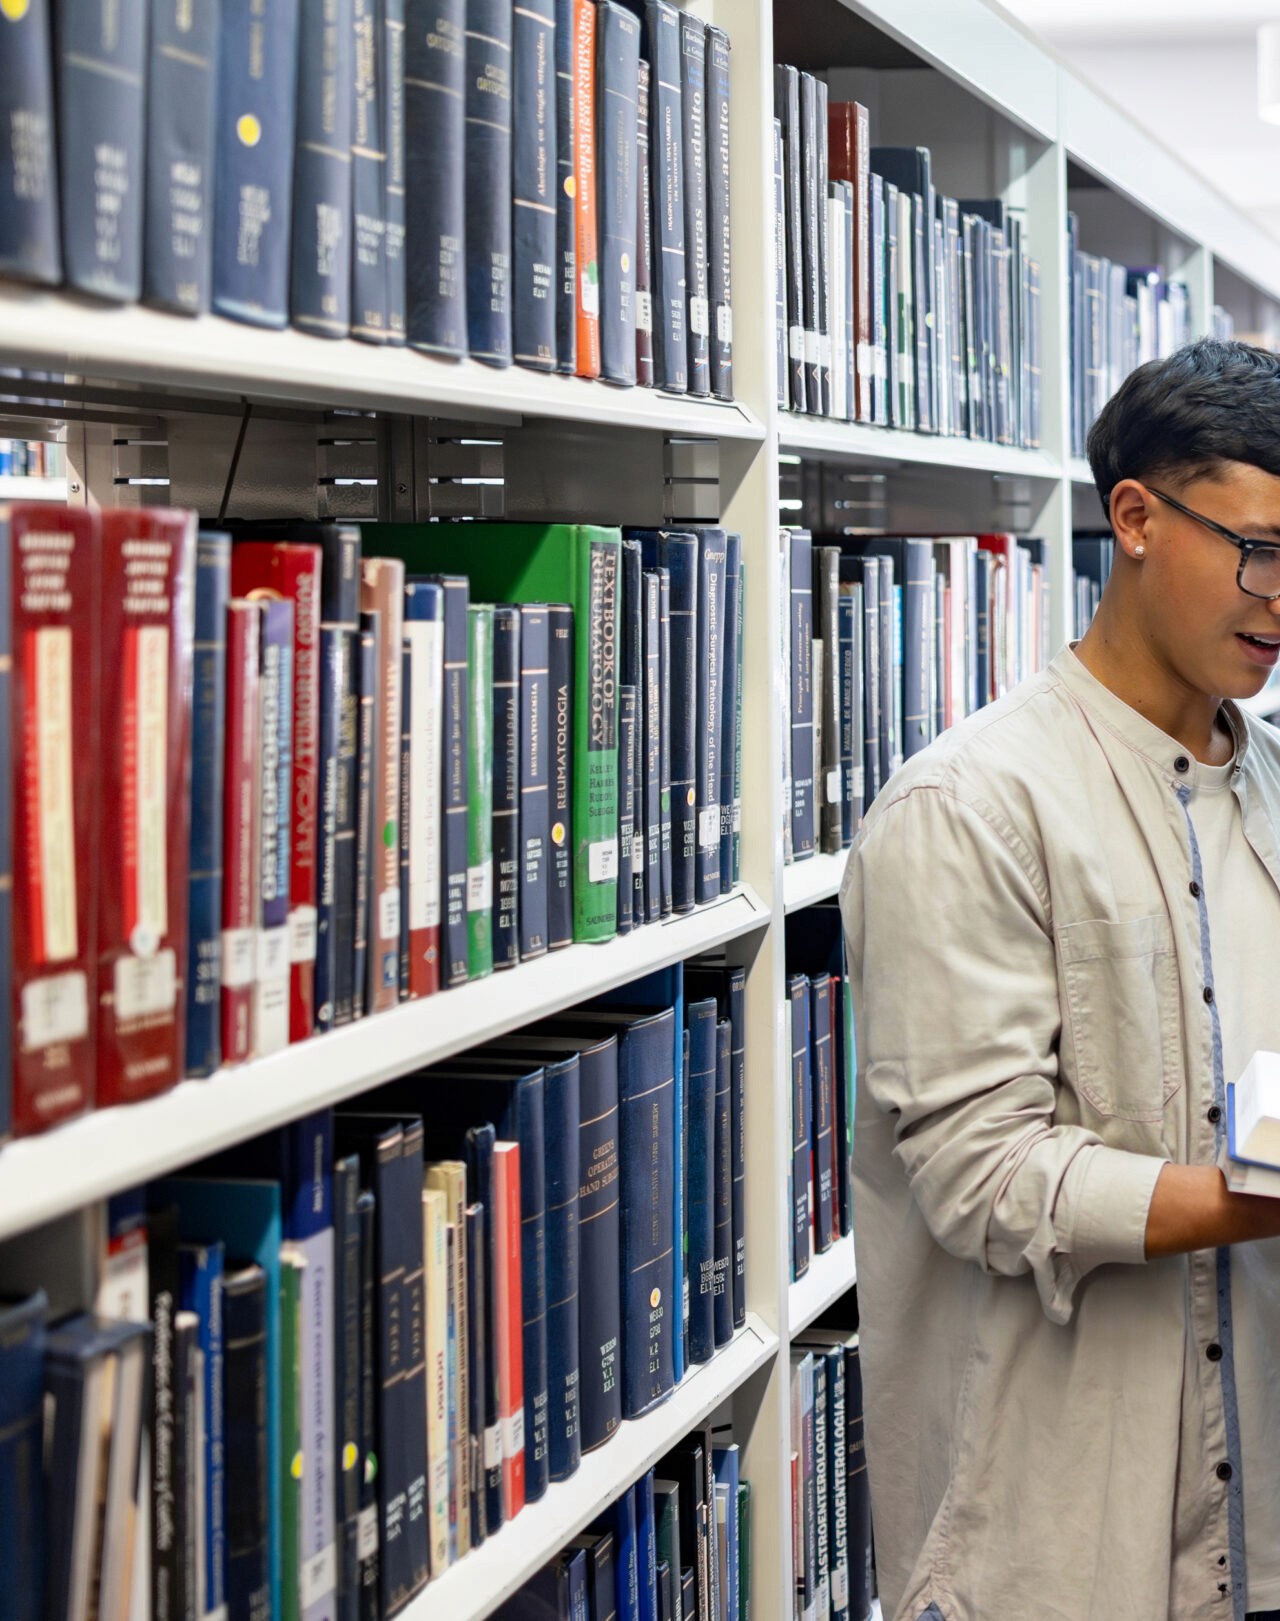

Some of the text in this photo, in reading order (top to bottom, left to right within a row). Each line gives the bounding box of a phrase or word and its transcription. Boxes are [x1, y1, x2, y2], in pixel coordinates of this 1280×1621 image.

[690, 92, 702, 168] adulto
[720, 101, 731, 175] adulto
[641, 165, 650, 270] ORTHOPEDICS
[704, 549, 725, 564] Gnepp
[591, 550, 604, 744] RHEUMATOLOGY
[603, 551, 616, 708] TEXTBOOK OF
[707, 572, 718, 802] Diagnostic Surgical Pathology of the Head
[844, 709, 852, 719] DE
[424, 708, 435, 789] músculos
[452, 743, 461, 756] de
[506, 697, 516, 800] REUMATOLOGIA
[530, 683, 538, 776] REUMATOLOGIA
[557, 684, 567, 809] REUMATOLOGIA
[626, 724, 634, 769] MOVILIDAD
[262, 645, 279, 899] OSTEOPOROSIS
[384, 660, 398, 887] ARTRITIS REUMOID
[423, 795, 434, 819] los
[626, 775, 633, 786] DE
[324, 816, 335, 833] de
[589, 806, 615, 817] SLEDGE
[322, 834, 335, 905] Síndrome
[579, 1180, 600, 1198] HAND
[649, 1307, 664, 1323] WE830
[314, 1431, 324, 1450] de
[815, 1414, 827, 1585] GASTROENTEROLOGIA
[833, 1401, 846, 1573] GASTROENTEROLOGIA
